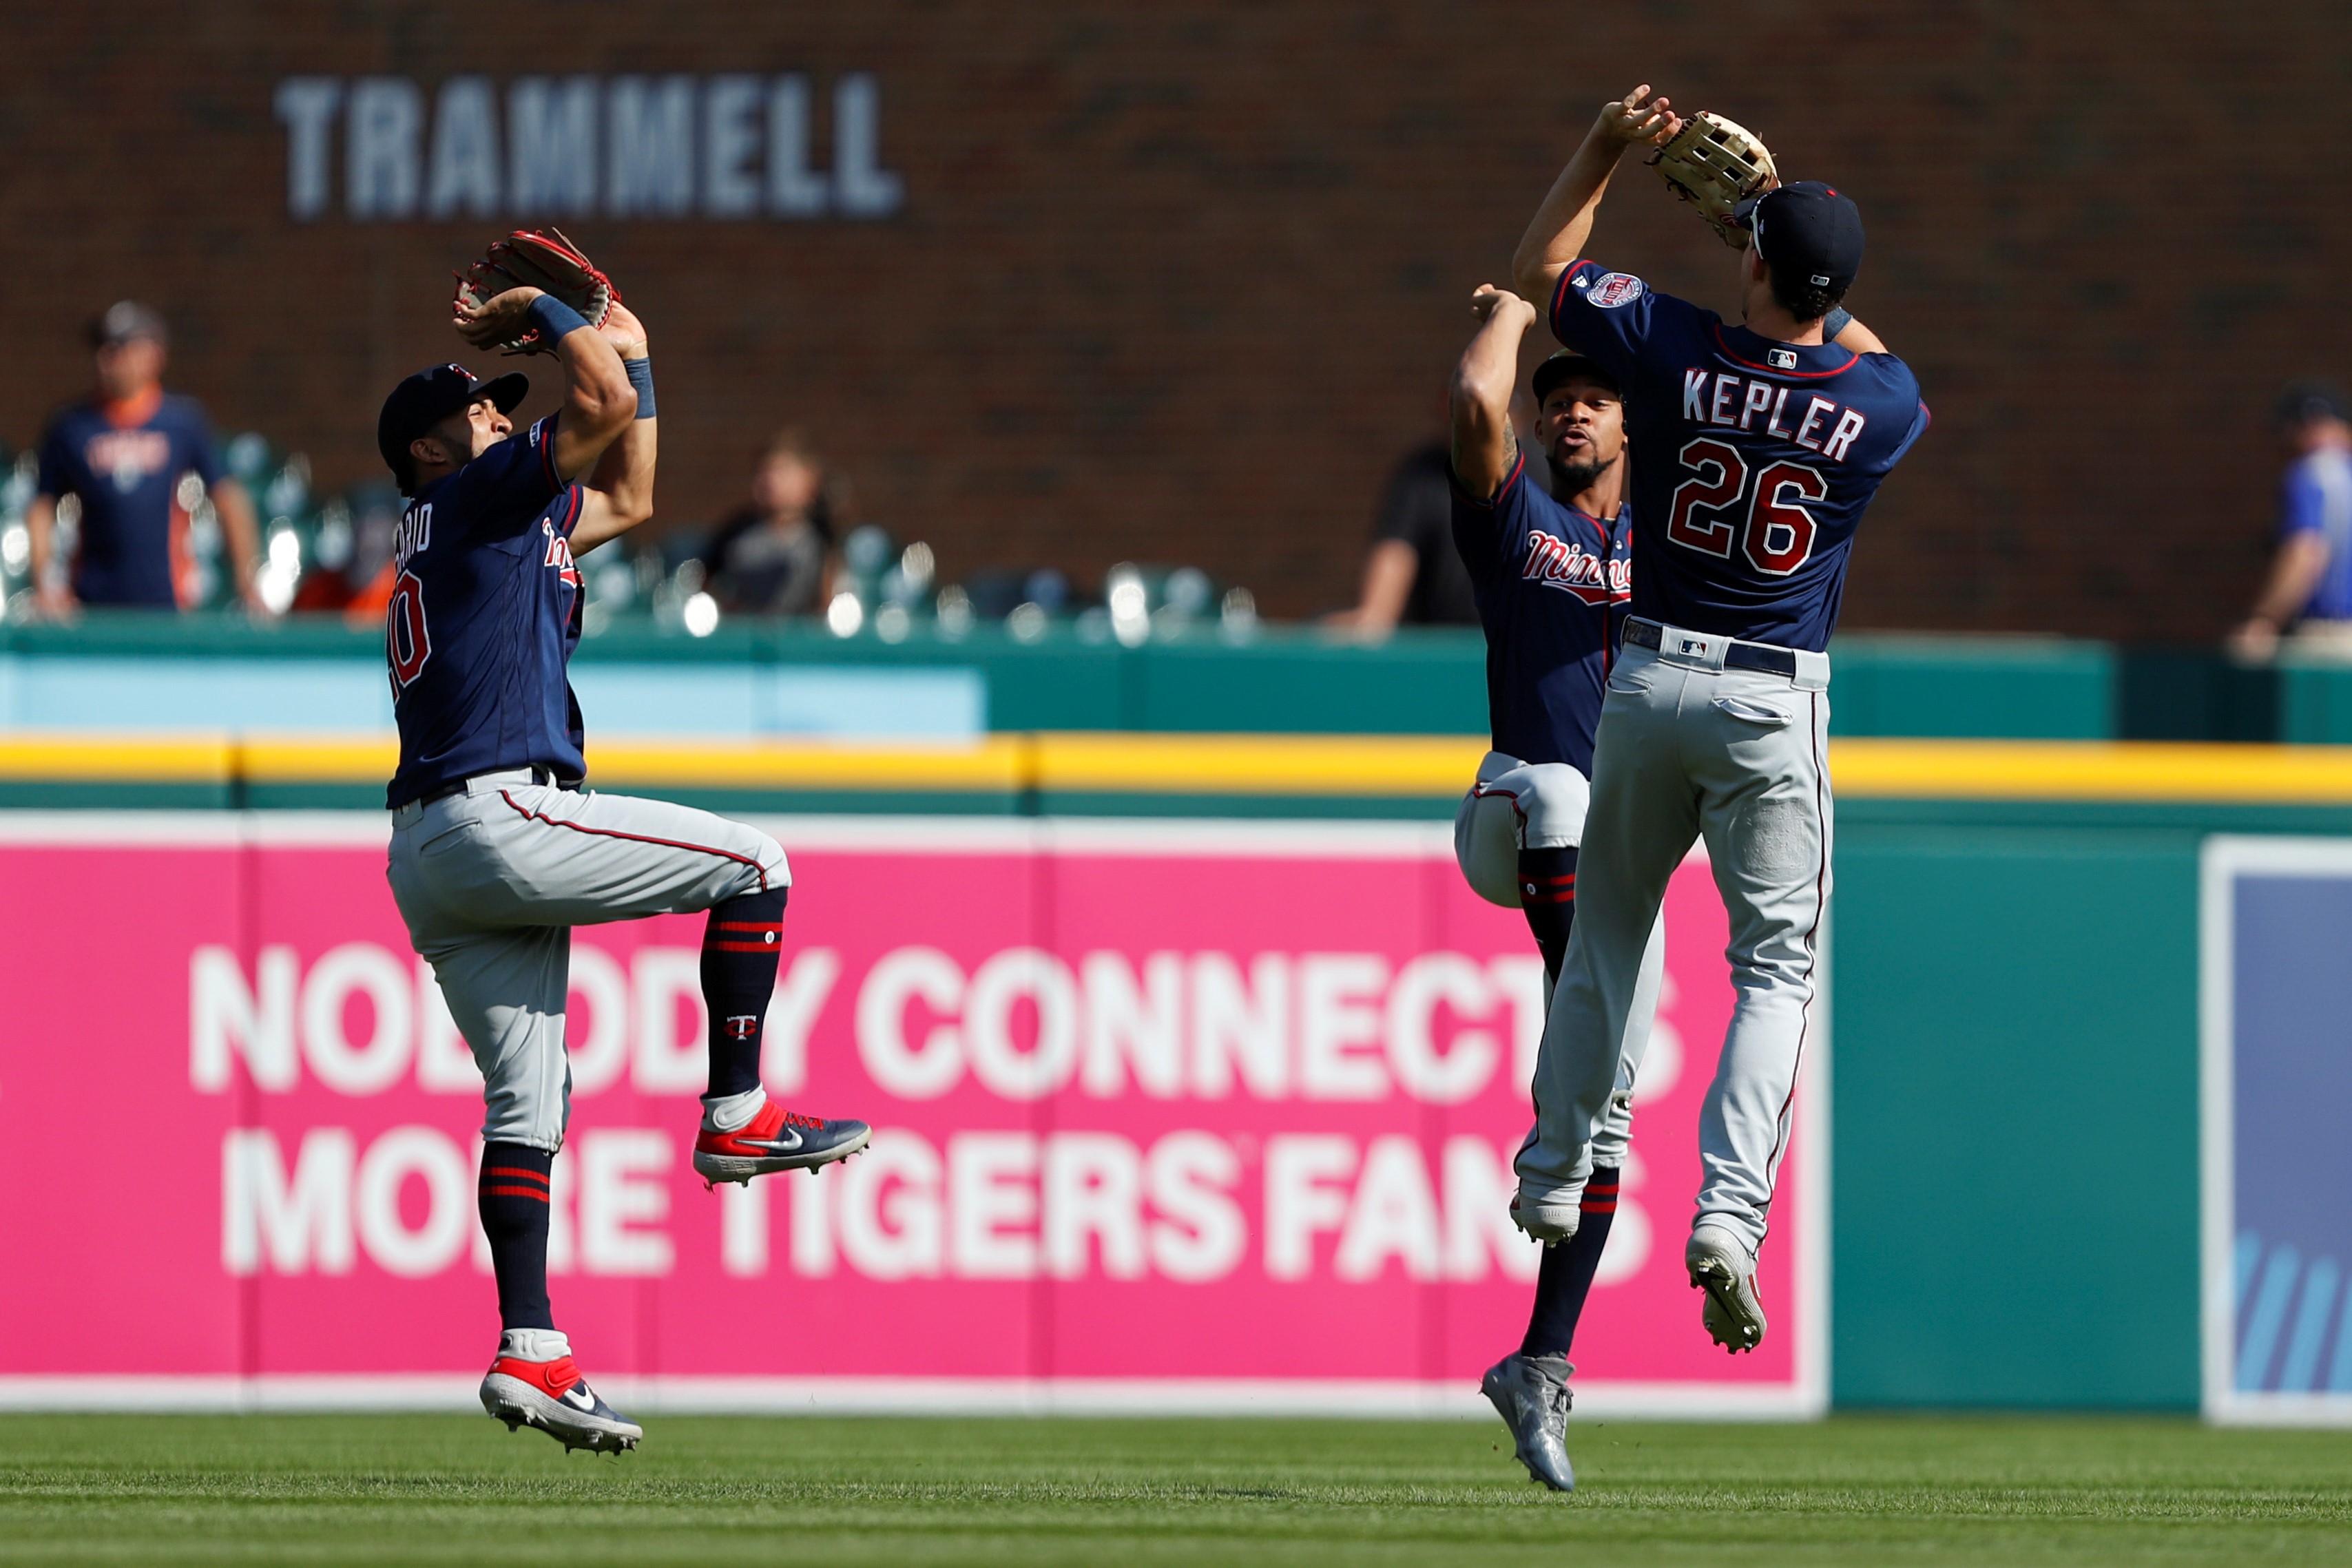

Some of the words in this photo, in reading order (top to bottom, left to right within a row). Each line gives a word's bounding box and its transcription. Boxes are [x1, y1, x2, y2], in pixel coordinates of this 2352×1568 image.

[278, 76, 897, 215] TRAMMELL
[1684, 368, 1867, 463] KEPLER
[1667, 437, 1828, 576] 26
